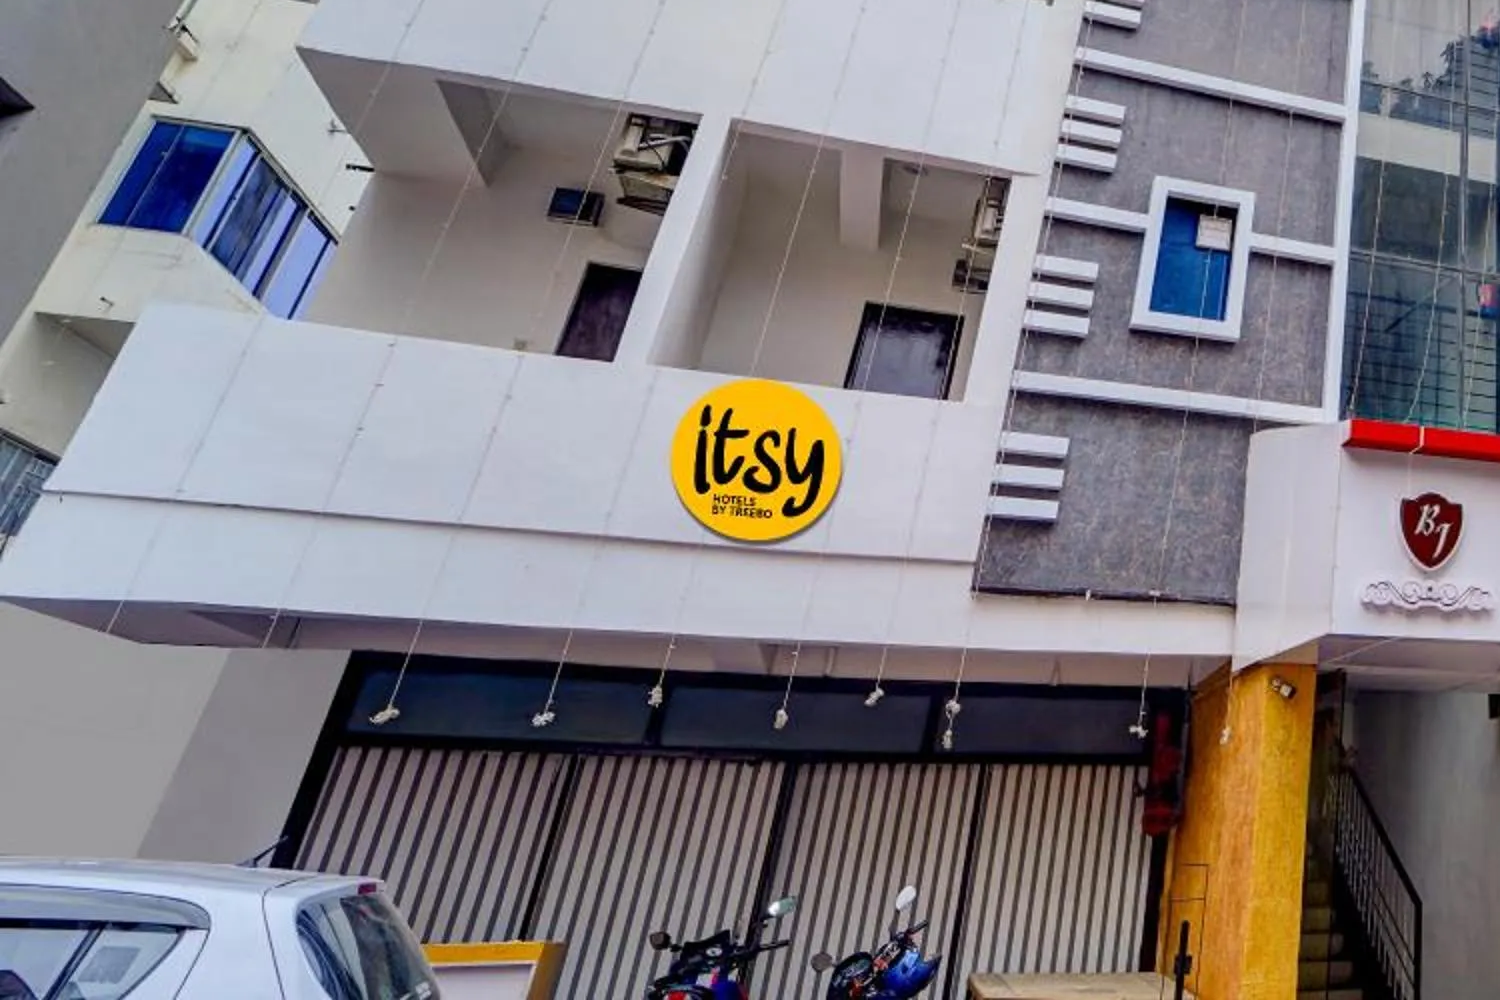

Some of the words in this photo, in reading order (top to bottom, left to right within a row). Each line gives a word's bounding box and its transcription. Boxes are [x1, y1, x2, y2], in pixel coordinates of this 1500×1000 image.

[694, 404, 825, 517] itsy
[713, 494, 756, 507] HOTELS
[712, 505, 726, 515] BY
[730, 506, 773, 518] TREEBO
